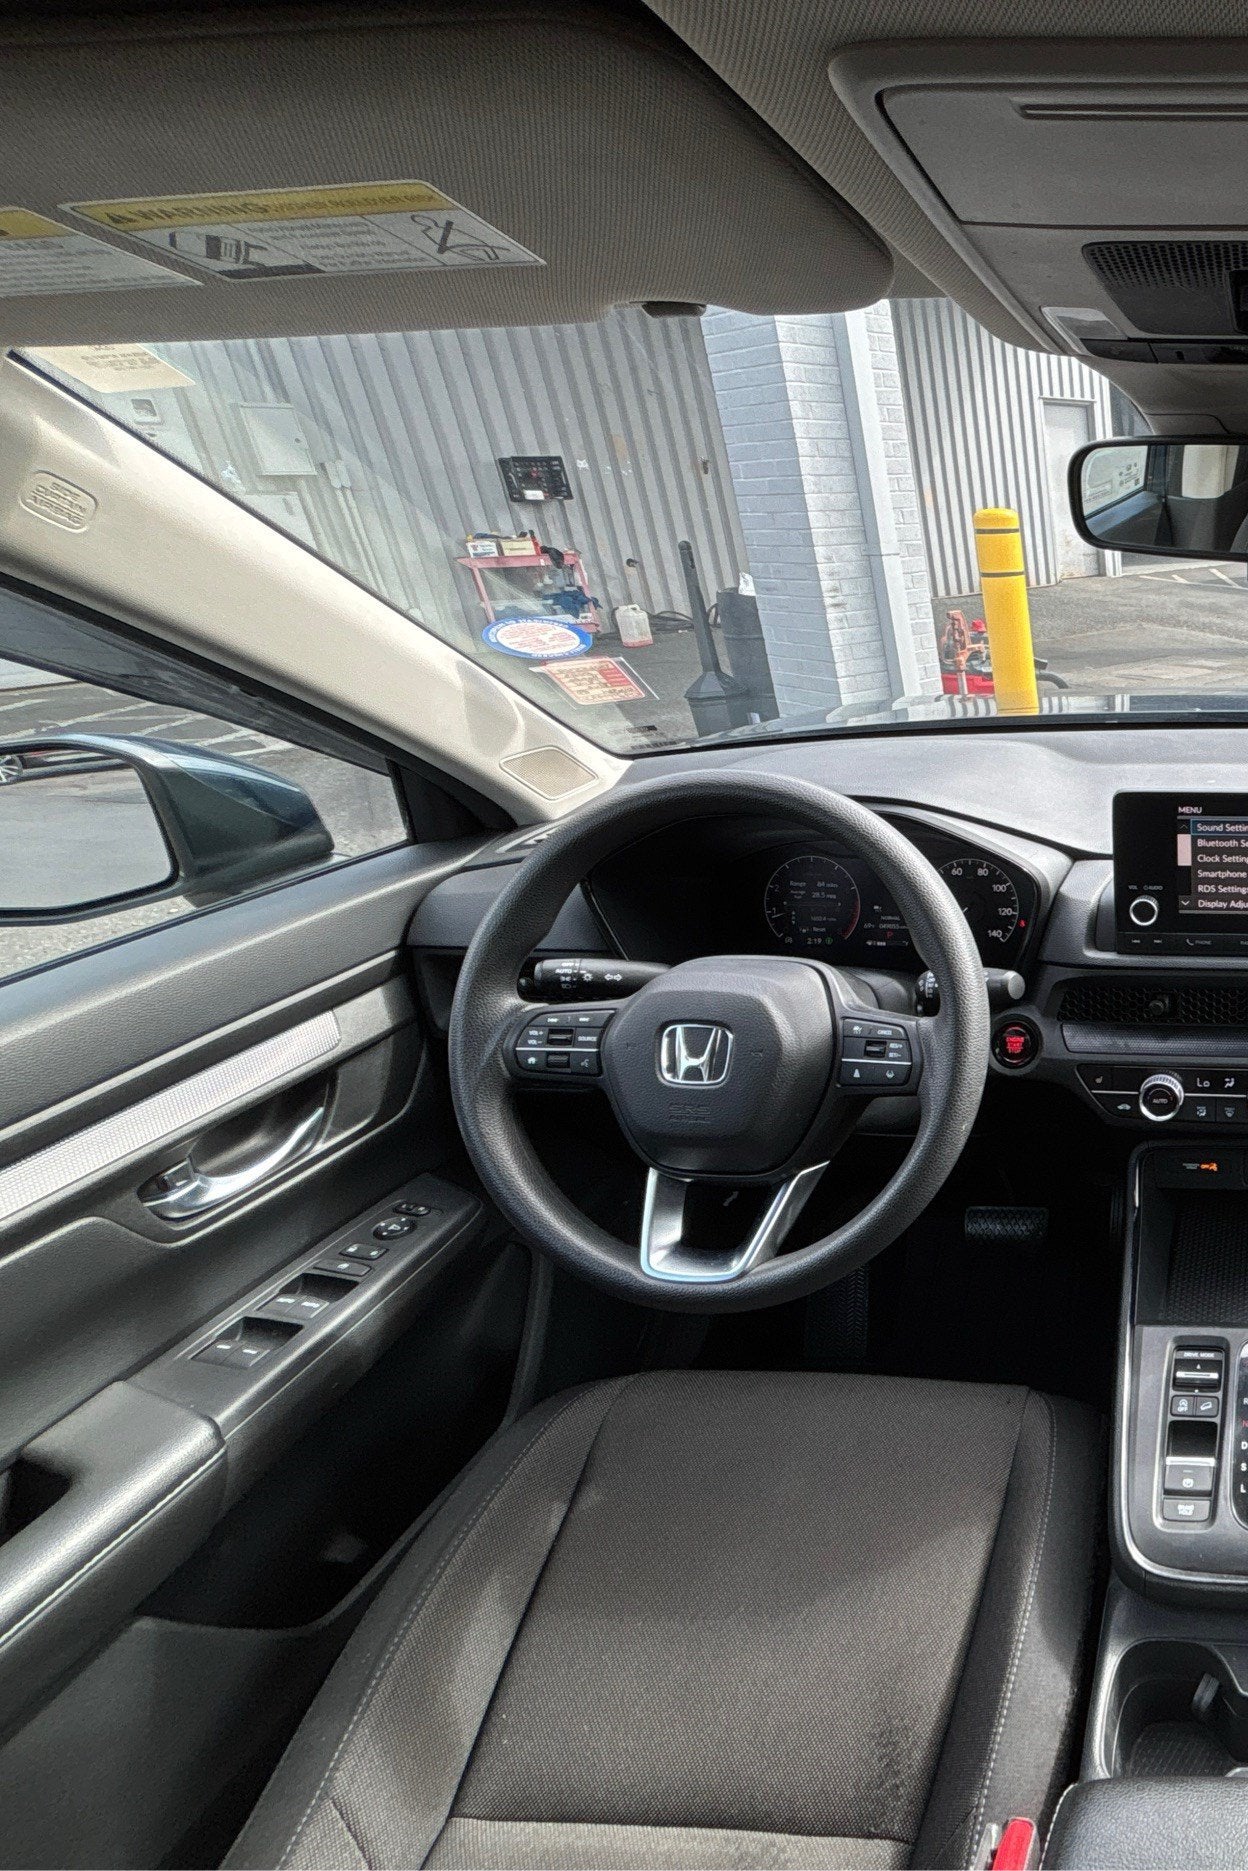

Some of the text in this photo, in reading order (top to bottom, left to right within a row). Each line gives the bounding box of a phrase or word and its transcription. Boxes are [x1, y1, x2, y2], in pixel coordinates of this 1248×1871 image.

[136, 201, 271, 221] WARNING
[1178, 806, 1203, 814] MENU
[1197, 823, 1224, 832] Sound
[1197, 838, 1239, 848] Bluetooth
[1197, 854, 1220, 863] Clock
[951, 867, 963, 876] 60
[977, 868, 989, 876] 80
[1197, 869, 1247, 879] Smartphone
[992, 884, 1007, 892] 100
[1197, 885, 1216, 893] RDS
[1197, 900, 1228, 909] Display
[998, 908, 1013, 916] 120
[988, 930, 1003, 938] 140
[1196, 1078, 1211, 1088] Lo
[1242, 1420, 1248, 1428] N
[1241, 1442, 1248, 1450] D
[1240, 1463, 1247, 1471] S
[1240, 1484, 1246, 1493] L
